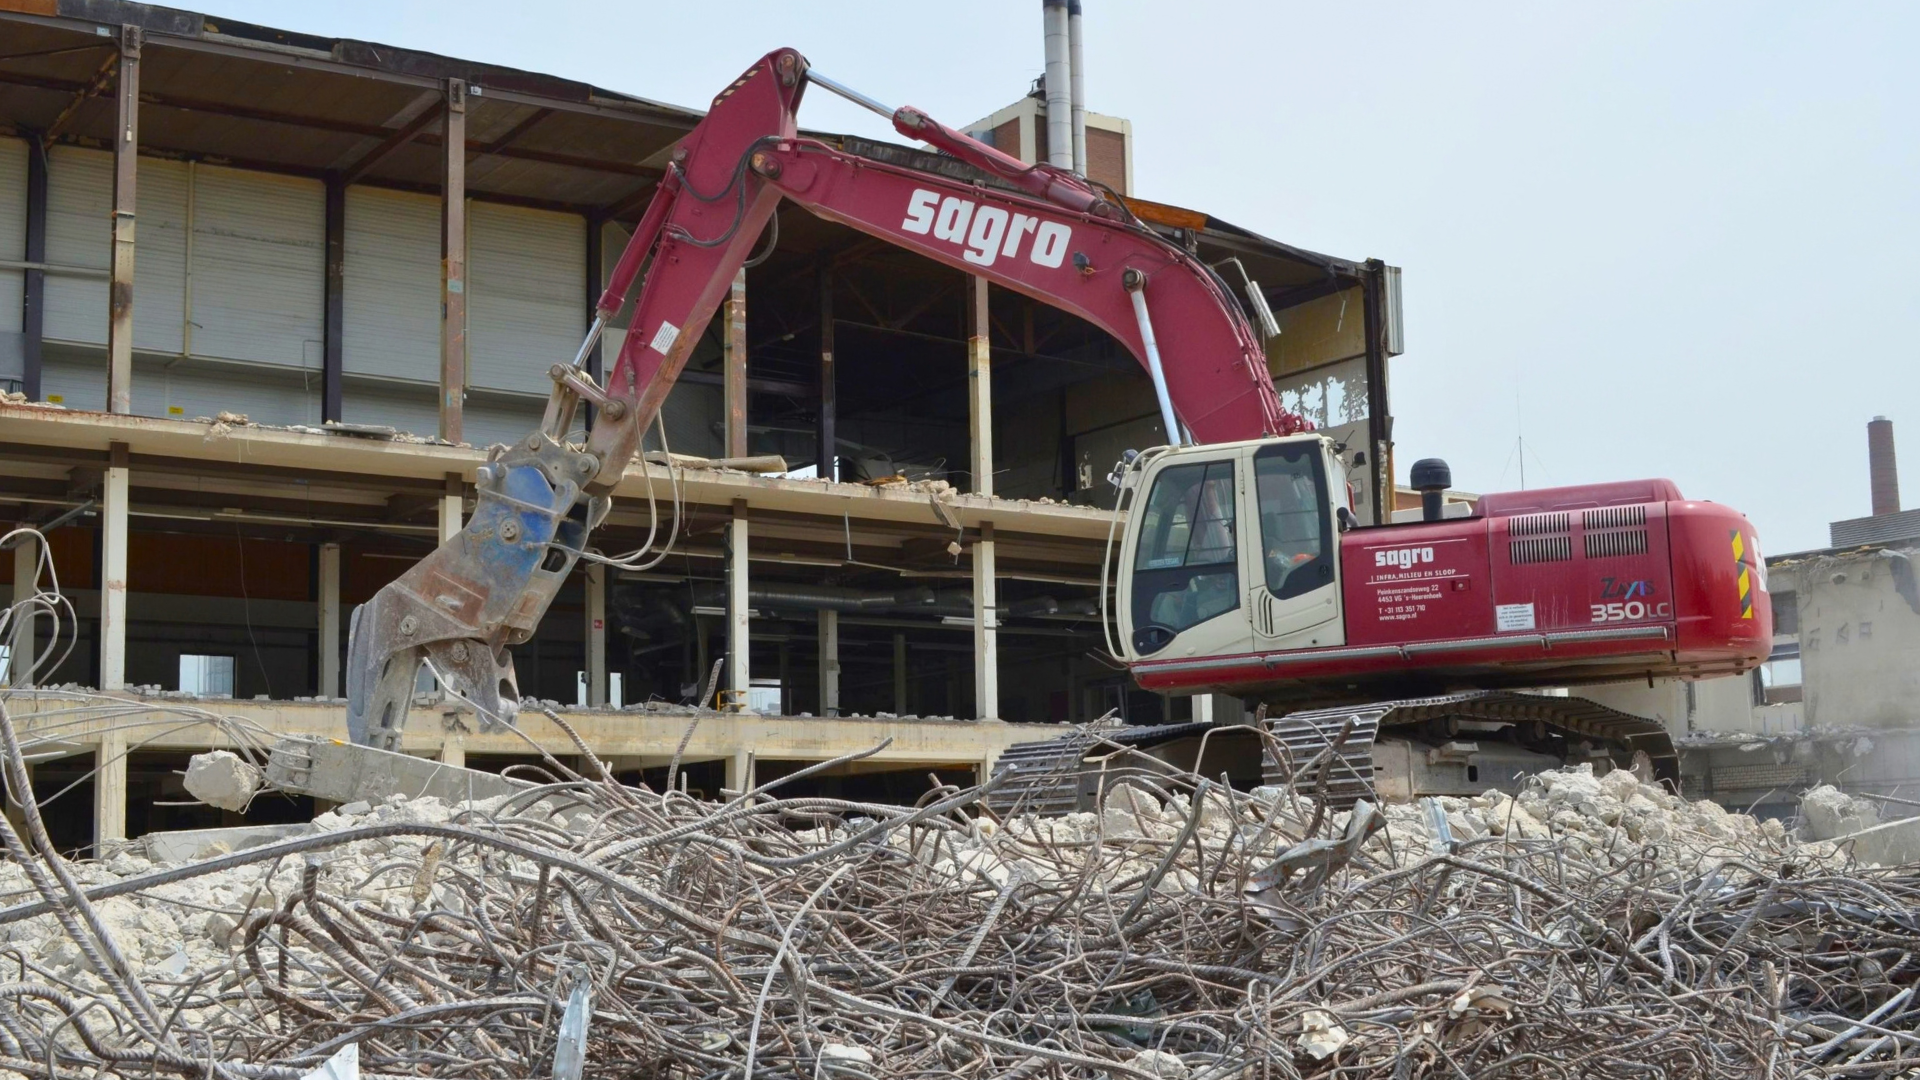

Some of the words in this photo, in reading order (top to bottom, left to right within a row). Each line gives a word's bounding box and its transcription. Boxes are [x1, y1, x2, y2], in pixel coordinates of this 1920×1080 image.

[901, 188, 1072, 269] sagro
[1375, 547, 1434, 569] sagro
[1435, 568, 1456, 576] SLOOP
[1377, 595, 1393, 603] 4453
[1379, 612, 1417, 621] www.sagro.nl
